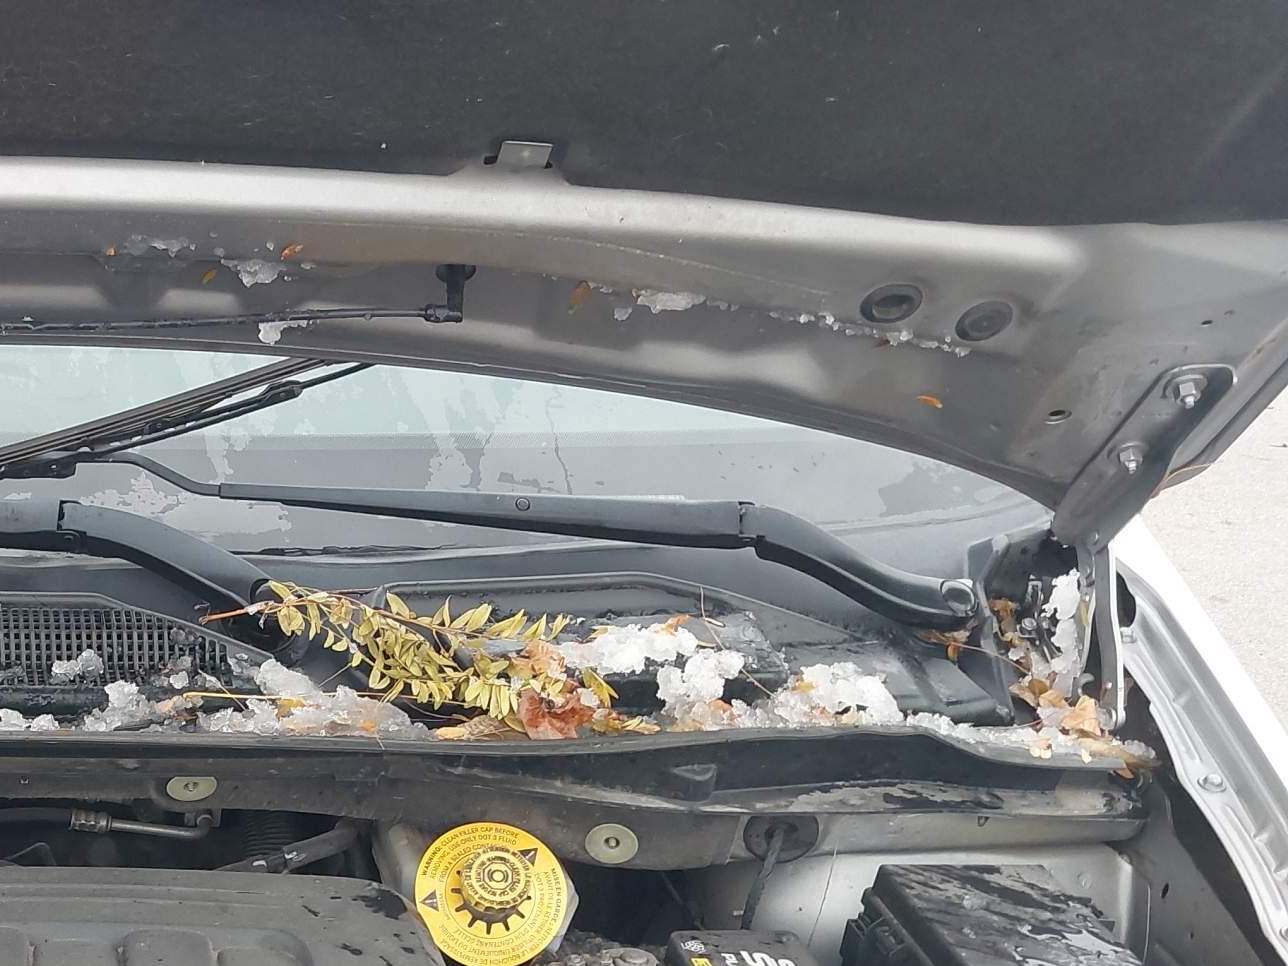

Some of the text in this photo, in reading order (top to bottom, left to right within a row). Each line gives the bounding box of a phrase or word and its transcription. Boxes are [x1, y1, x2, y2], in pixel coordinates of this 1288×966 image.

[458, 826, 479, 838] FILLER
[494, 827, 520, 838] BEFORE
[549, 867, 560, 885] MISE
[555, 886, 561, 896] EN
[550, 898, 561, 923] GARDE
